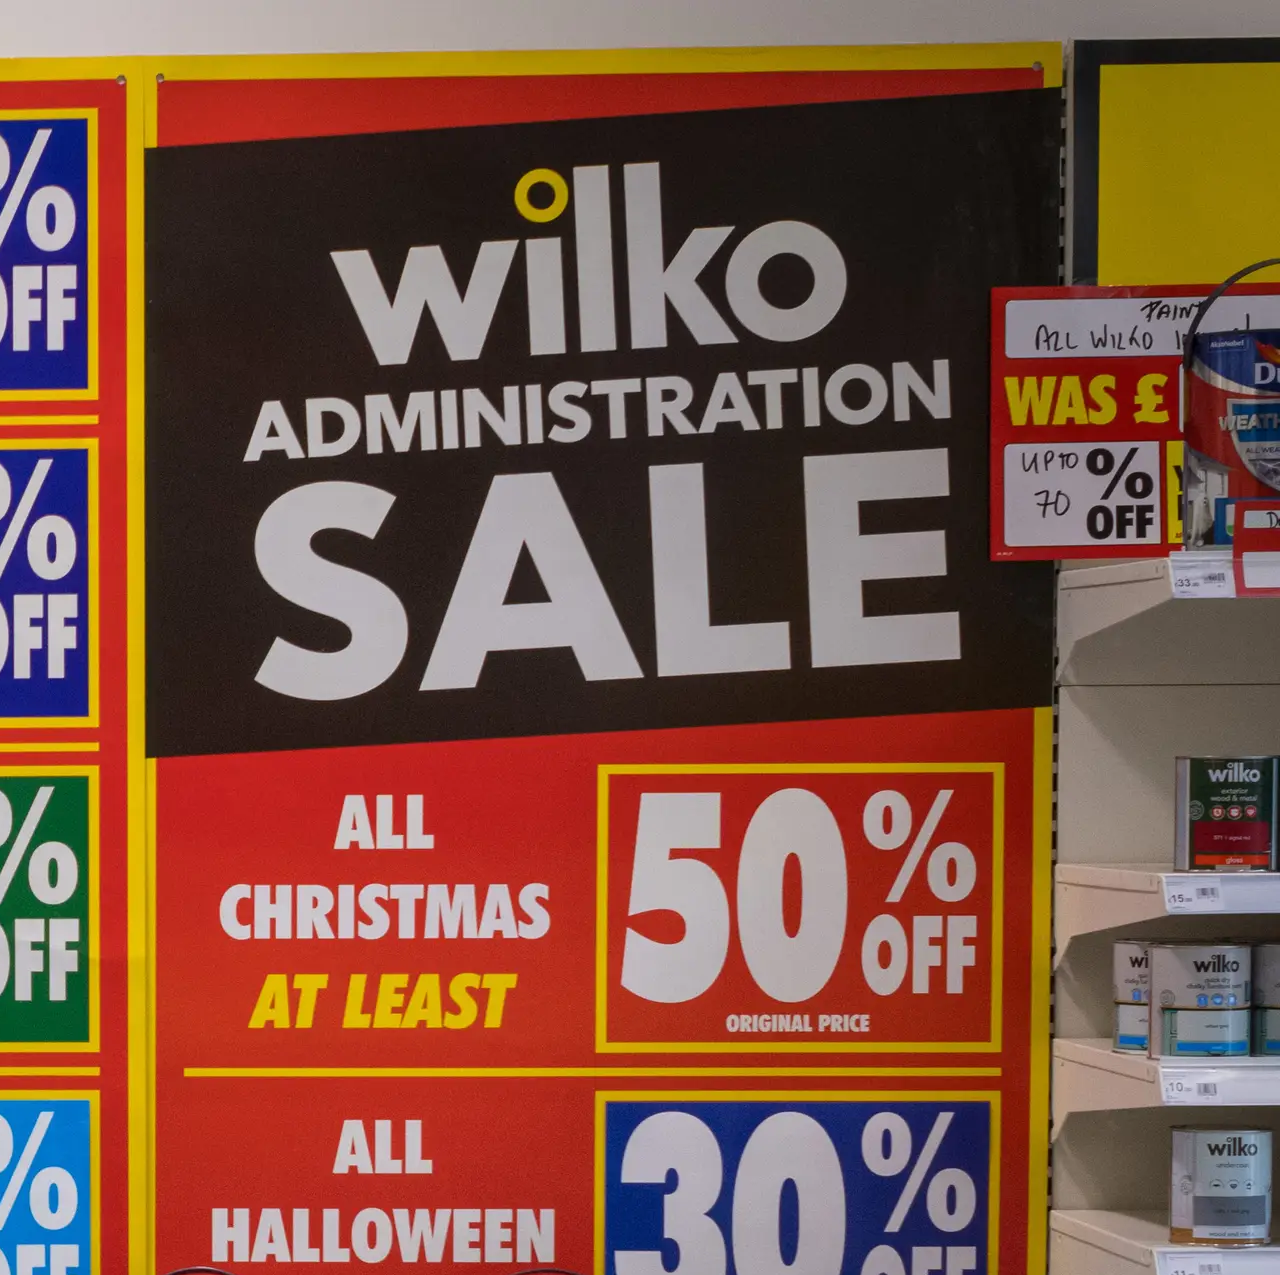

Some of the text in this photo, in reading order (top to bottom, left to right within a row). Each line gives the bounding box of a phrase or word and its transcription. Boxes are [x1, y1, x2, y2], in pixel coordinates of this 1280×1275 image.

[330, 161, 848, 366] wilko
[1035, 324, 1153, 350] ALL WILKO
[243, 358, 952, 463] ADMINISTRATION
[1004, 373, 1169, 426] WAS £
[1035, 490, 1070, 518] 70
[1087, 504, 1154, 539] OFF
[253, 448, 962, 702] SALE
[1208, 762, 1260, 783] wilko
[334, 794, 434, 850] ALL
[219, 882, 551, 940] CHRISTMAS
[861, 915, 977, 996] OFF
[247, 972, 518, 1029] AT LEAST
[726, 1014, 870, 1033] ORIGINAL PRICE
[332, 1119, 433, 1175] ALL
[210, 1207, 555, 1264] HALLOWEEN
